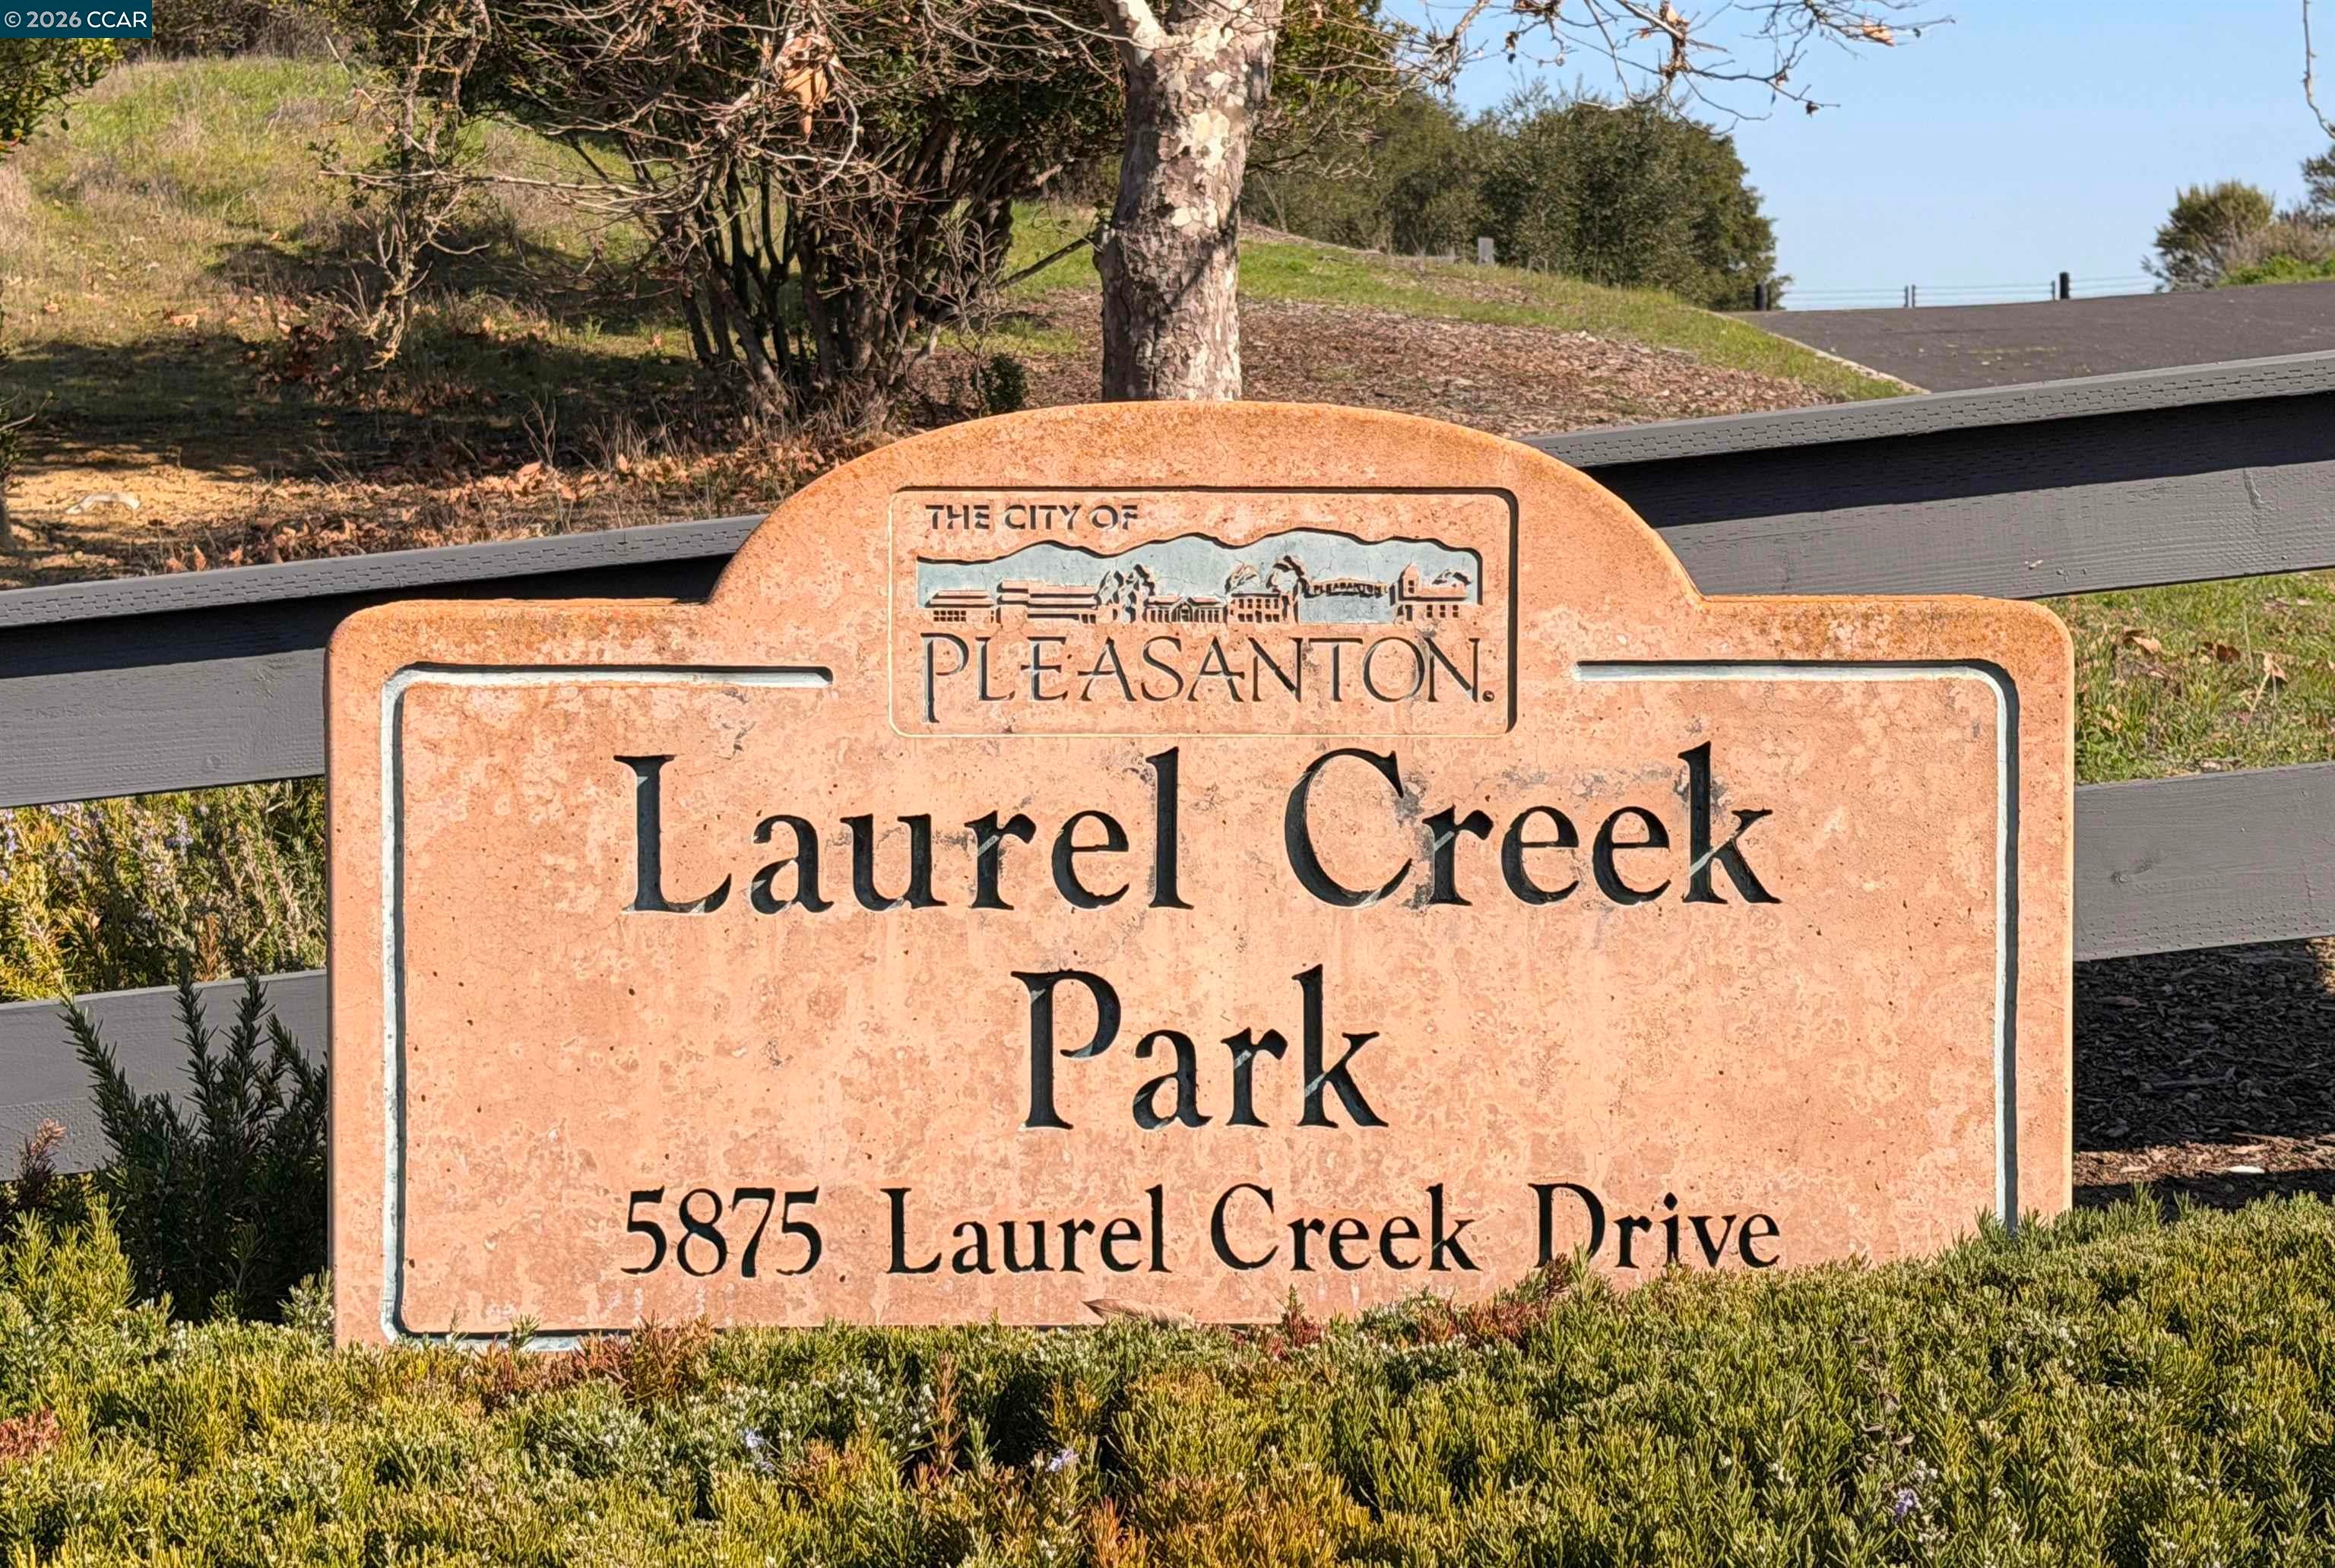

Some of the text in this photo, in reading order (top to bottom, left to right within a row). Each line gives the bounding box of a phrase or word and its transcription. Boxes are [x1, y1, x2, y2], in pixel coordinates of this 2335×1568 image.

[925, 505, 1139, 531] THE CITY OF
[614, 741, 1781, 914] Laurel Creek
[1011, 965, 1389, 1129] Park
[620, 1182, 1781, 1278] 5875 Laurel Creek Drive
